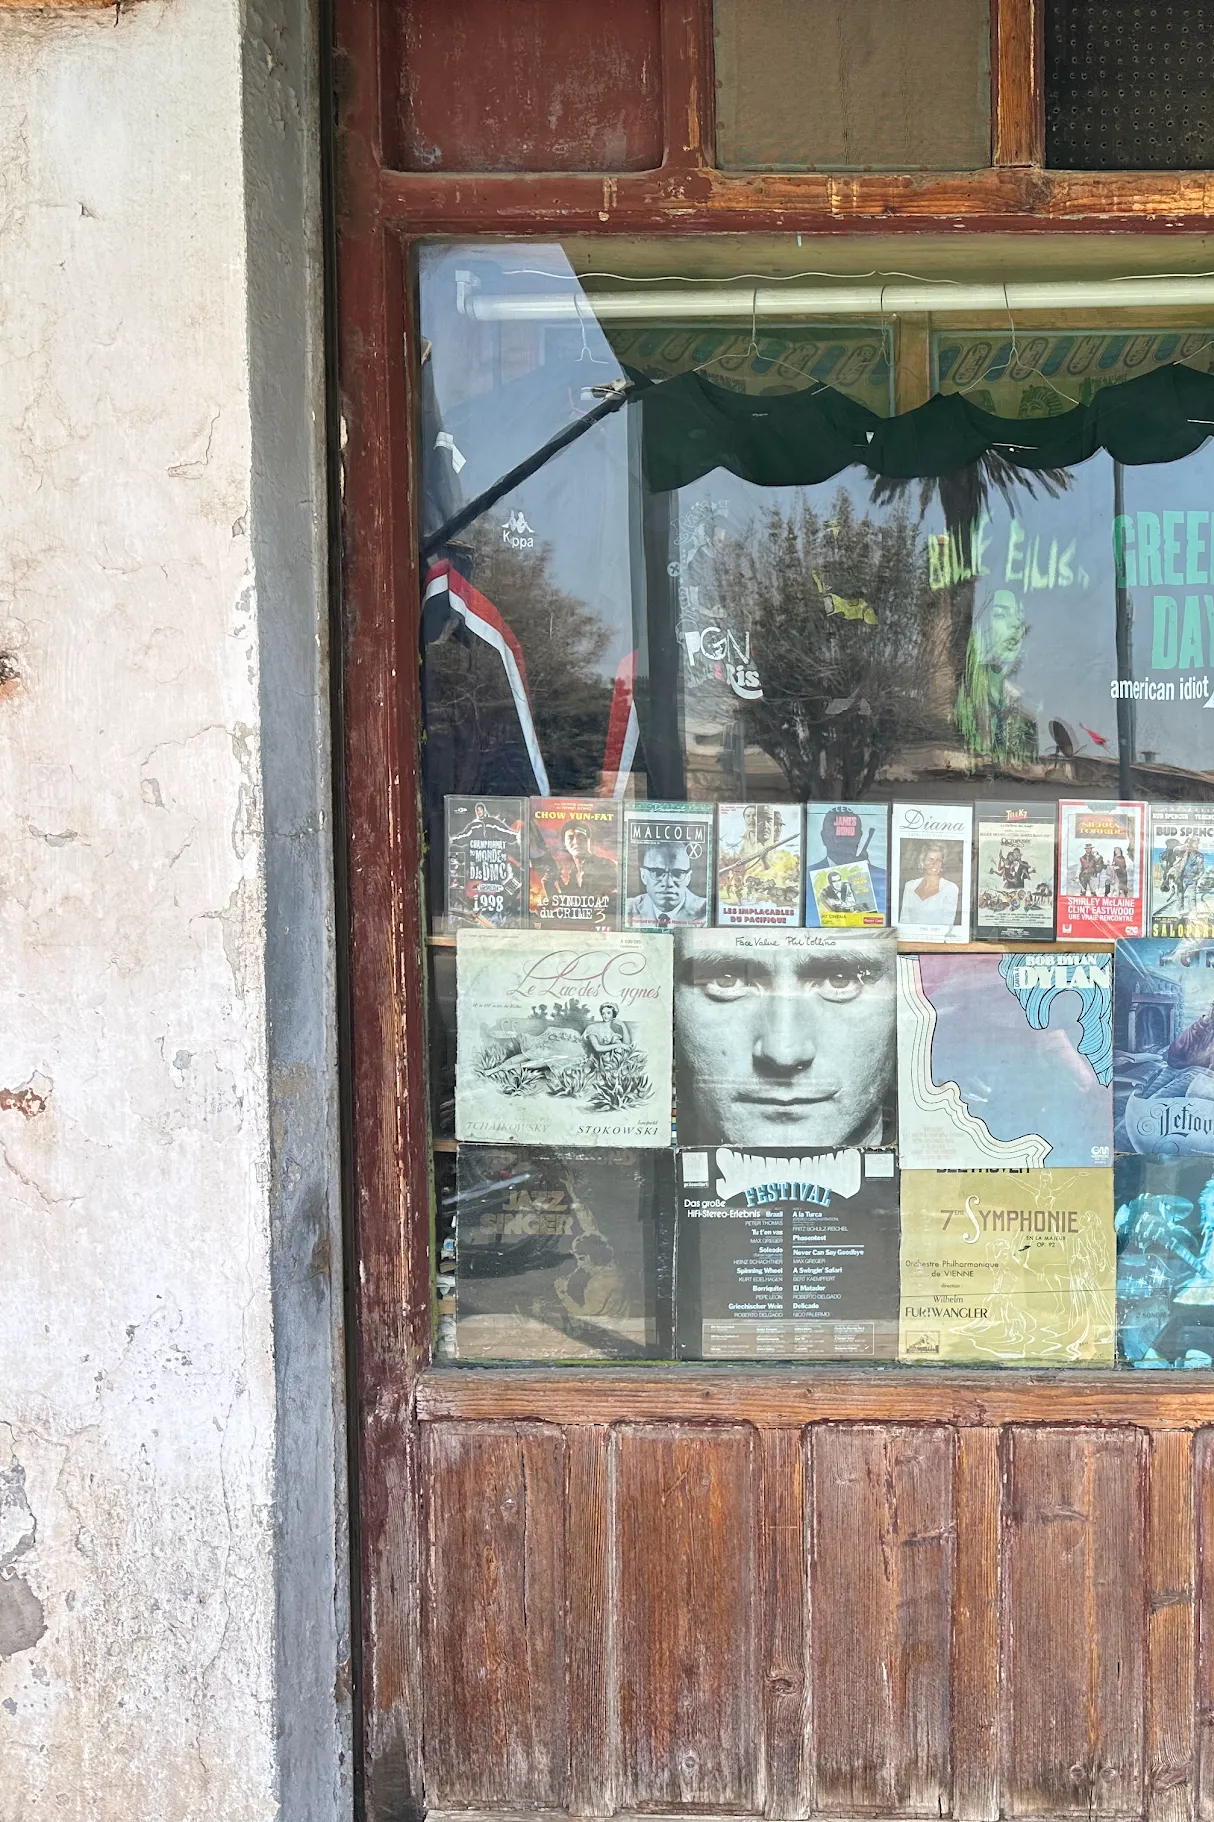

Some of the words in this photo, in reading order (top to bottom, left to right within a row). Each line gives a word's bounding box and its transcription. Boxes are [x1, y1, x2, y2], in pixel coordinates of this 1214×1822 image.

[502, 530, 534, 550] Kppa
[1110, 677, 1174, 700] american
[1179, 676, 1209, 700] idiot
[534, 811, 567, 820] CHOW
[570, 811, 614, 821] YUN-FAT
[834, 816, 857, 827] JAMES
[900, 808, 965, 833] Diana
[632, 825, 703, 841] MALCOLM
[836, 826, 856, 837] BOND
[1156, 827, 1178, 838] BUD
[482, 863, 507, 882] DMC
[473, 895, 504, 912] 1998
[552, 895, 609, 907] SYNDICAT
[1068, 898, 1099, 906] SHIRLEY
[1102, 898, 1134, 907] McLAINE
[553, 908, 592, 920] CRIME
[594, 908, 606, 923] 3
[723, 907, 738, 915] LES
[738, 907, 794, 917] IMPLACABLES
[1068, 906, 1090, 914] CLINT
[1092, 906, 1134, 915] EASTWOOD
[745, 916, 787, 924] PACIFIQUE
[1081, 914, 1098, 922] VRAIE
[1100, 914, 1133, 922] RENCONTRE
[735, 936, 753, 947] Face
[754, 937, 780, 947] Value
[577, 981, 602, 998] des
[601, 952, 661, 1006] Cygnes
[1019, 966, 1110, 988] DYLAN
[576, 1125, 659, 1136] STOKOWSKI
[744, 1182, 832, 1208] FESTIVAL
[503, 1190, 568, 1212] JAZZ
[684, 1199, 700, 1208] Das
[701, 1200, 726, 1209] große
[480, 1212, 574, 1235] SINGER
[962, 1195, 1078, 1244] SYMPHONIE
[905, 1260, 940, 1268] Orchestre
[942, 1260, 999, 1270] Philharmonique
[944, 1270, 974, 1278] VIENNE
[933, 1295, 964, 1304] Wilhelm
